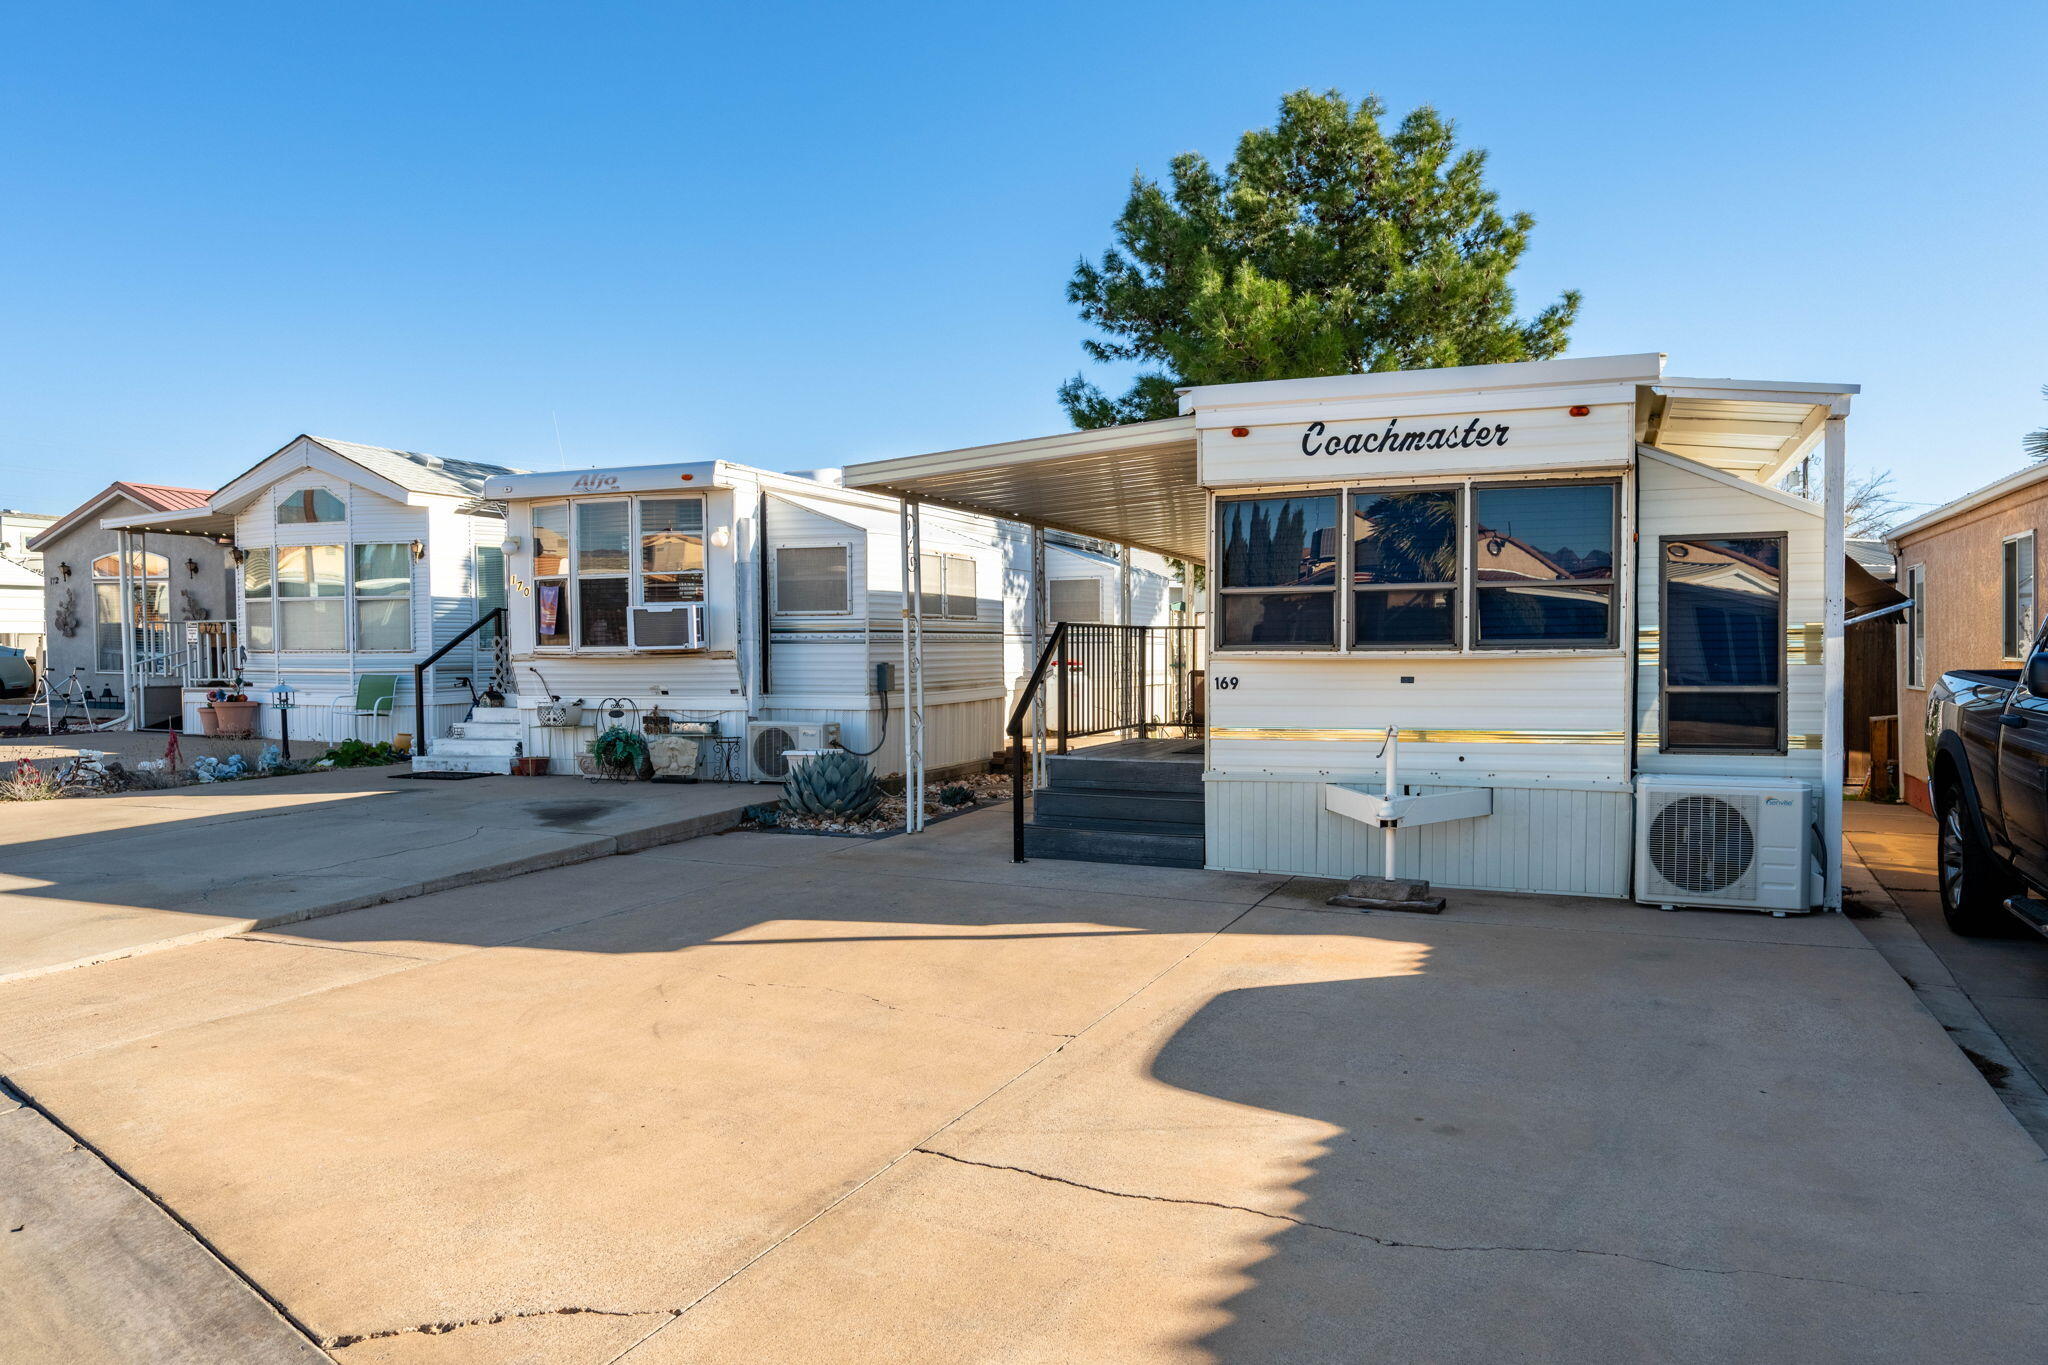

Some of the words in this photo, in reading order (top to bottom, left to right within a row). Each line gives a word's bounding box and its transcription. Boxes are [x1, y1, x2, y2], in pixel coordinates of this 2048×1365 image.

[1302, 418, 1510, 456] Coachmaster
[572, 473, 618, 489] Aljo
[510, 575, 530, 597] 170
[1214, 676, 1239, 690] 169
